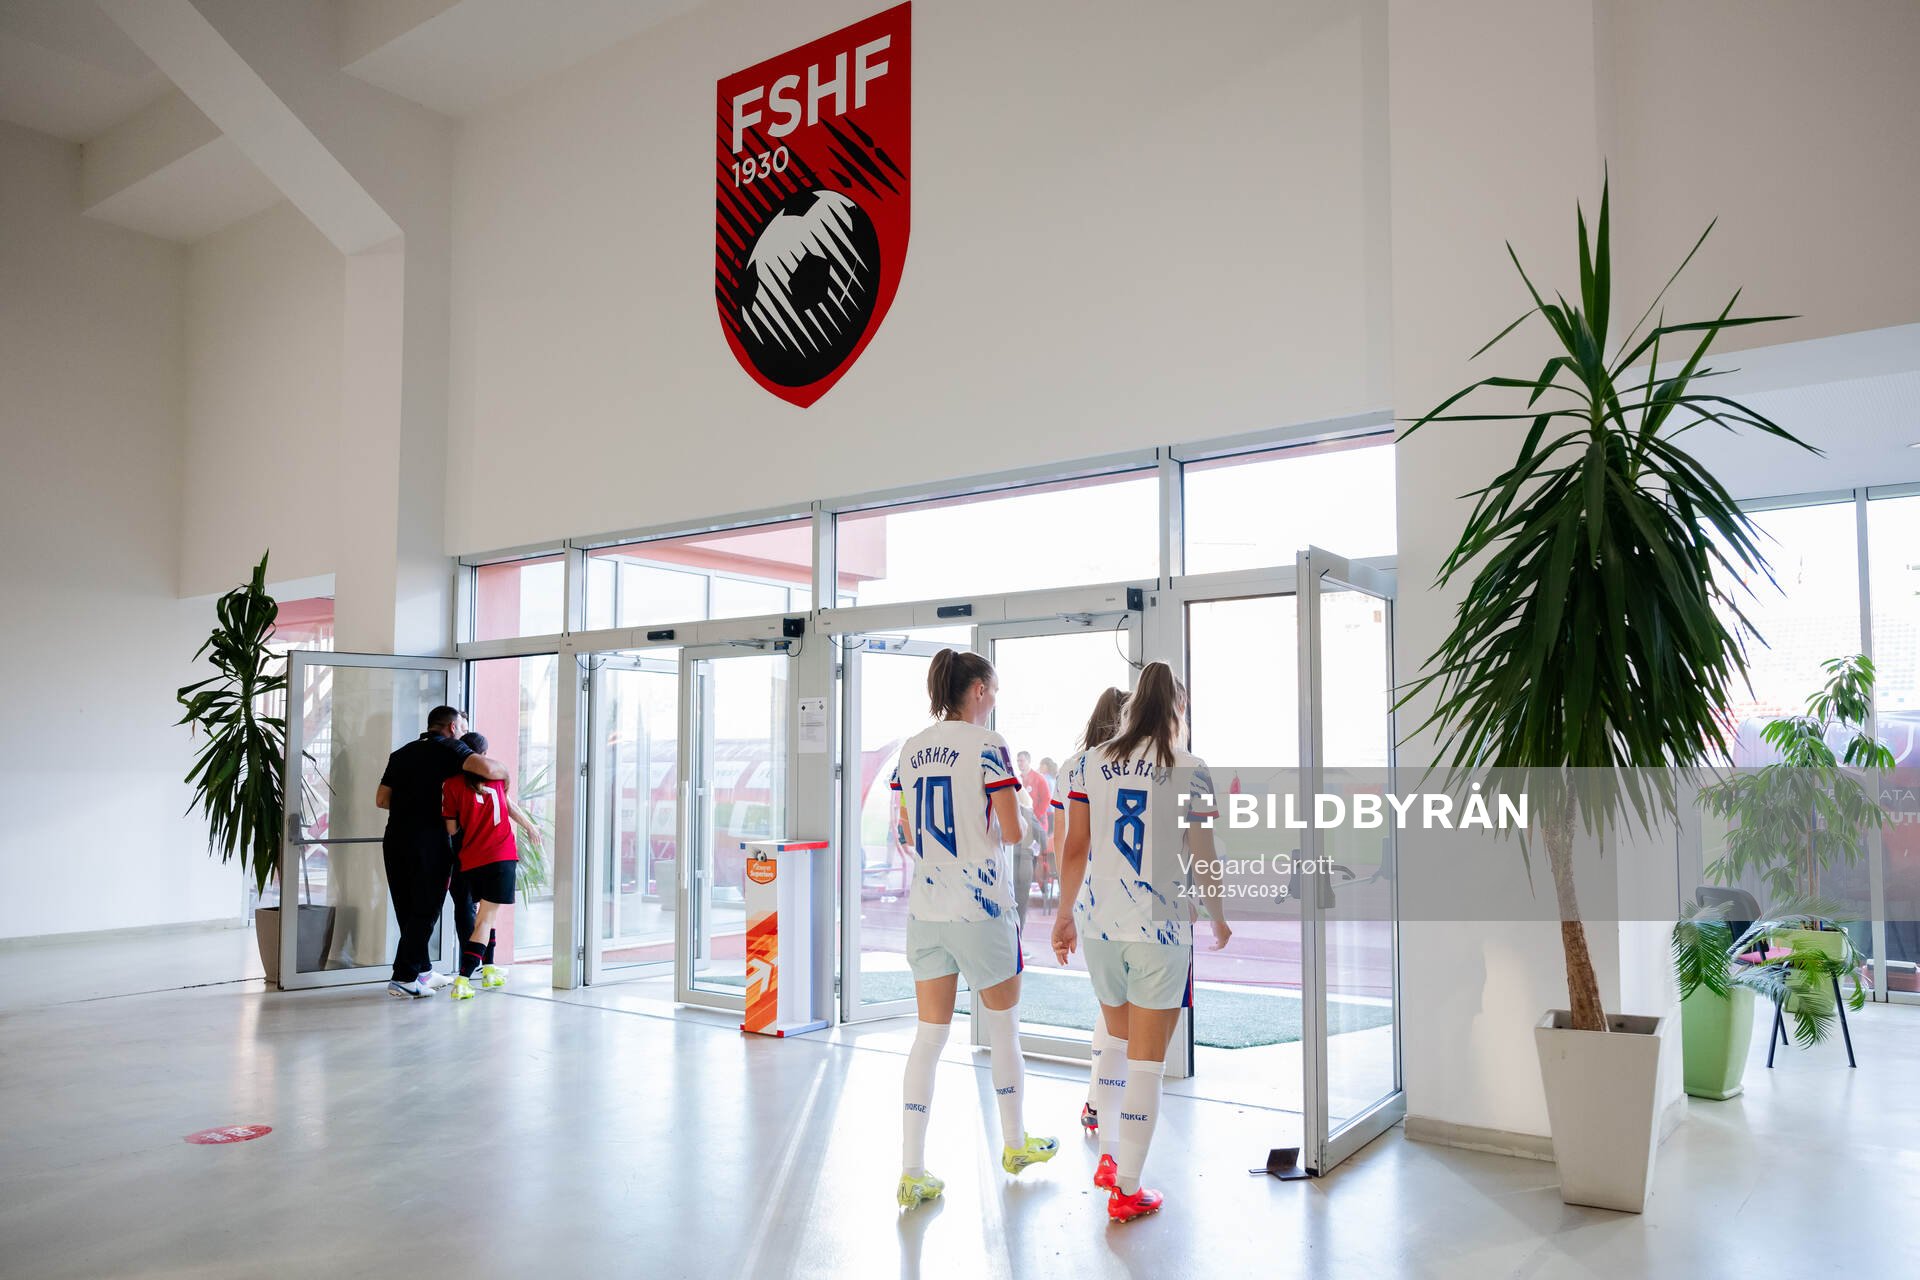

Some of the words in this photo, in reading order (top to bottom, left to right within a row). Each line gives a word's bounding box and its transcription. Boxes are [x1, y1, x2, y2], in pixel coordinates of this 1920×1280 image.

[732, 34, 891, 155] FSHF
[732, 146, 789, 188] 1930
[911, 747, 960, 769] GRAHAM
[912, 775, 958, 859] 10
[1113, 788, 1148, 877] 8
[1098, 1078, 1127, 1088] NORGE
[905, 1103, 927, 1113] NORGE
[1121, 1112, 1149, 1121] NORGE
